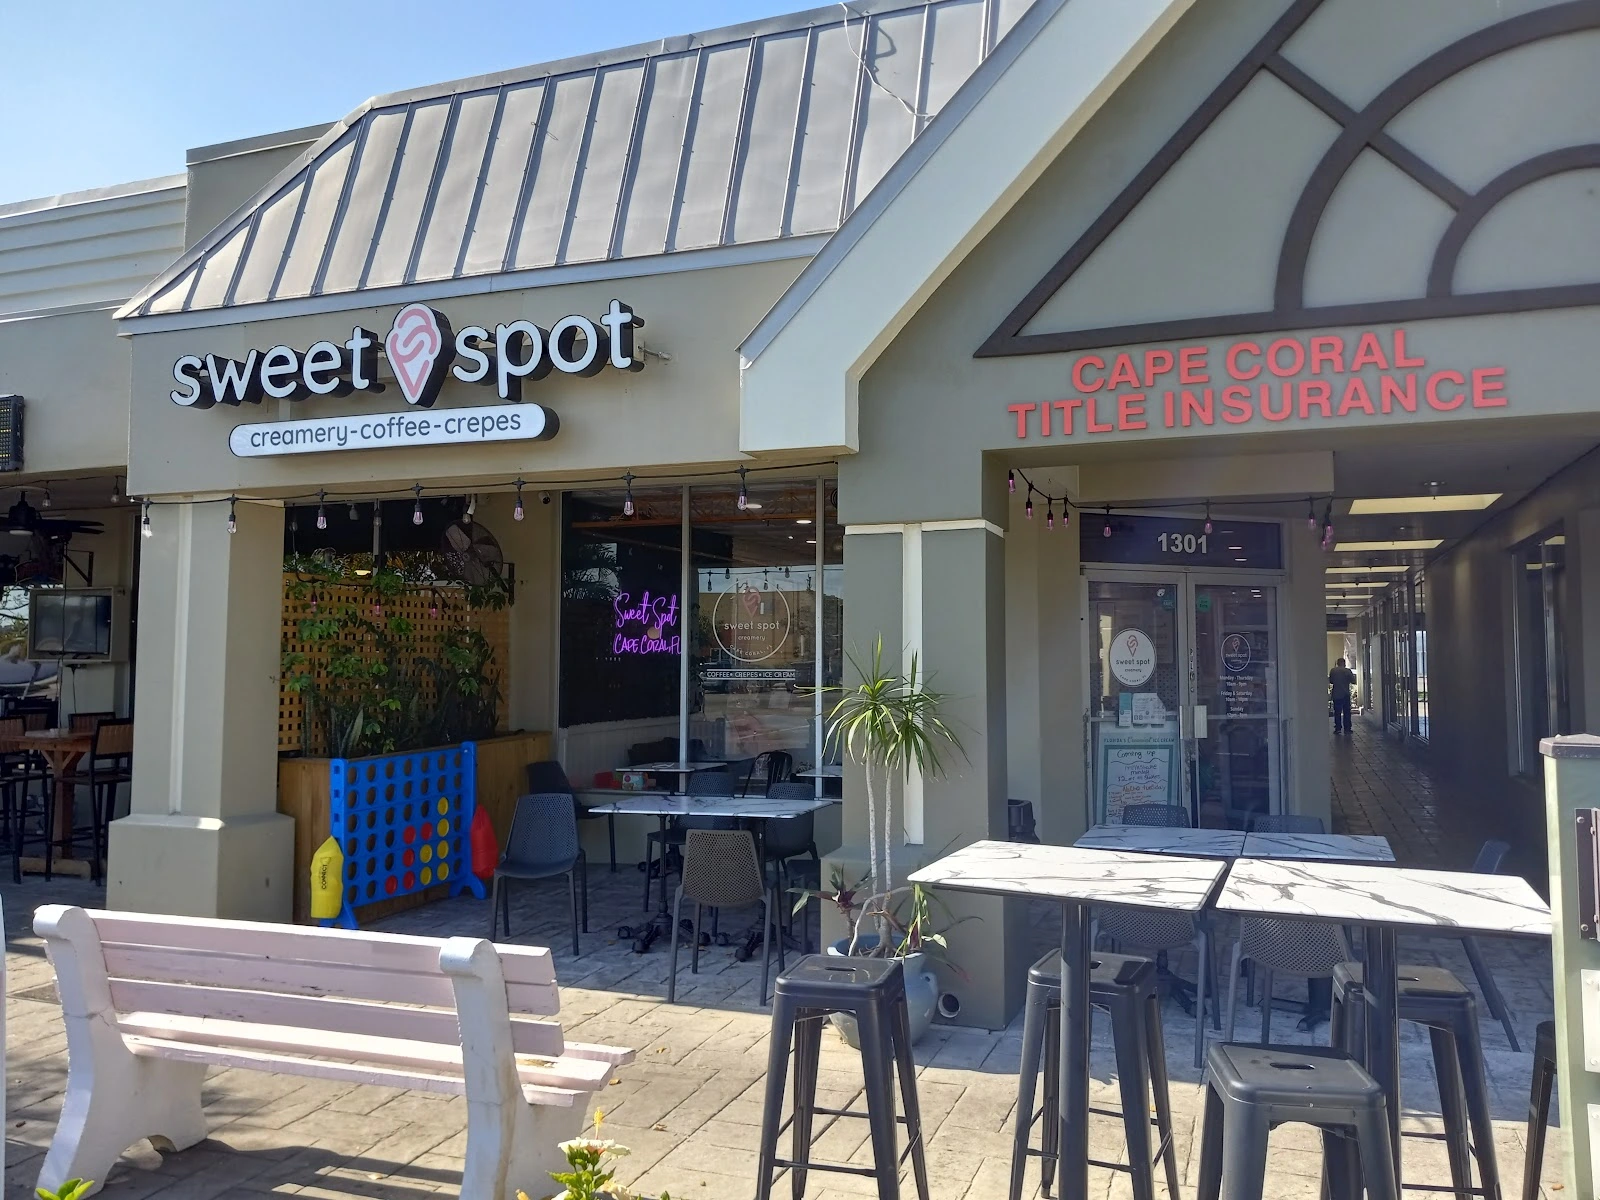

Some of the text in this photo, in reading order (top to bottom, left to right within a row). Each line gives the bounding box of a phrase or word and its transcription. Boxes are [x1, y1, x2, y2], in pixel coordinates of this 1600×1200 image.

[170, 298, 634, 408] sweet spot
[1071, 329, 1426, 393] CAPE CORAL
[1007, 367, 1508, 439] TITLE INSURANCE
[249, 411, 522, 448] creamery-coffee-crepes
[1157, 532, 1207, 554] 1301
[613, 591, 680, 639] Sweet Spot
[724, 620, 780, 632] sweet spot
[613, 632, 640, 655] CAPE
[737, 634, 766, 642] creamery
[1115, 657, 1151, 667] sweet spot
[706, 670, 796, 679] COFFEE CREPES ICE CREAM
[1117, 749, 1143, 760] Coming
